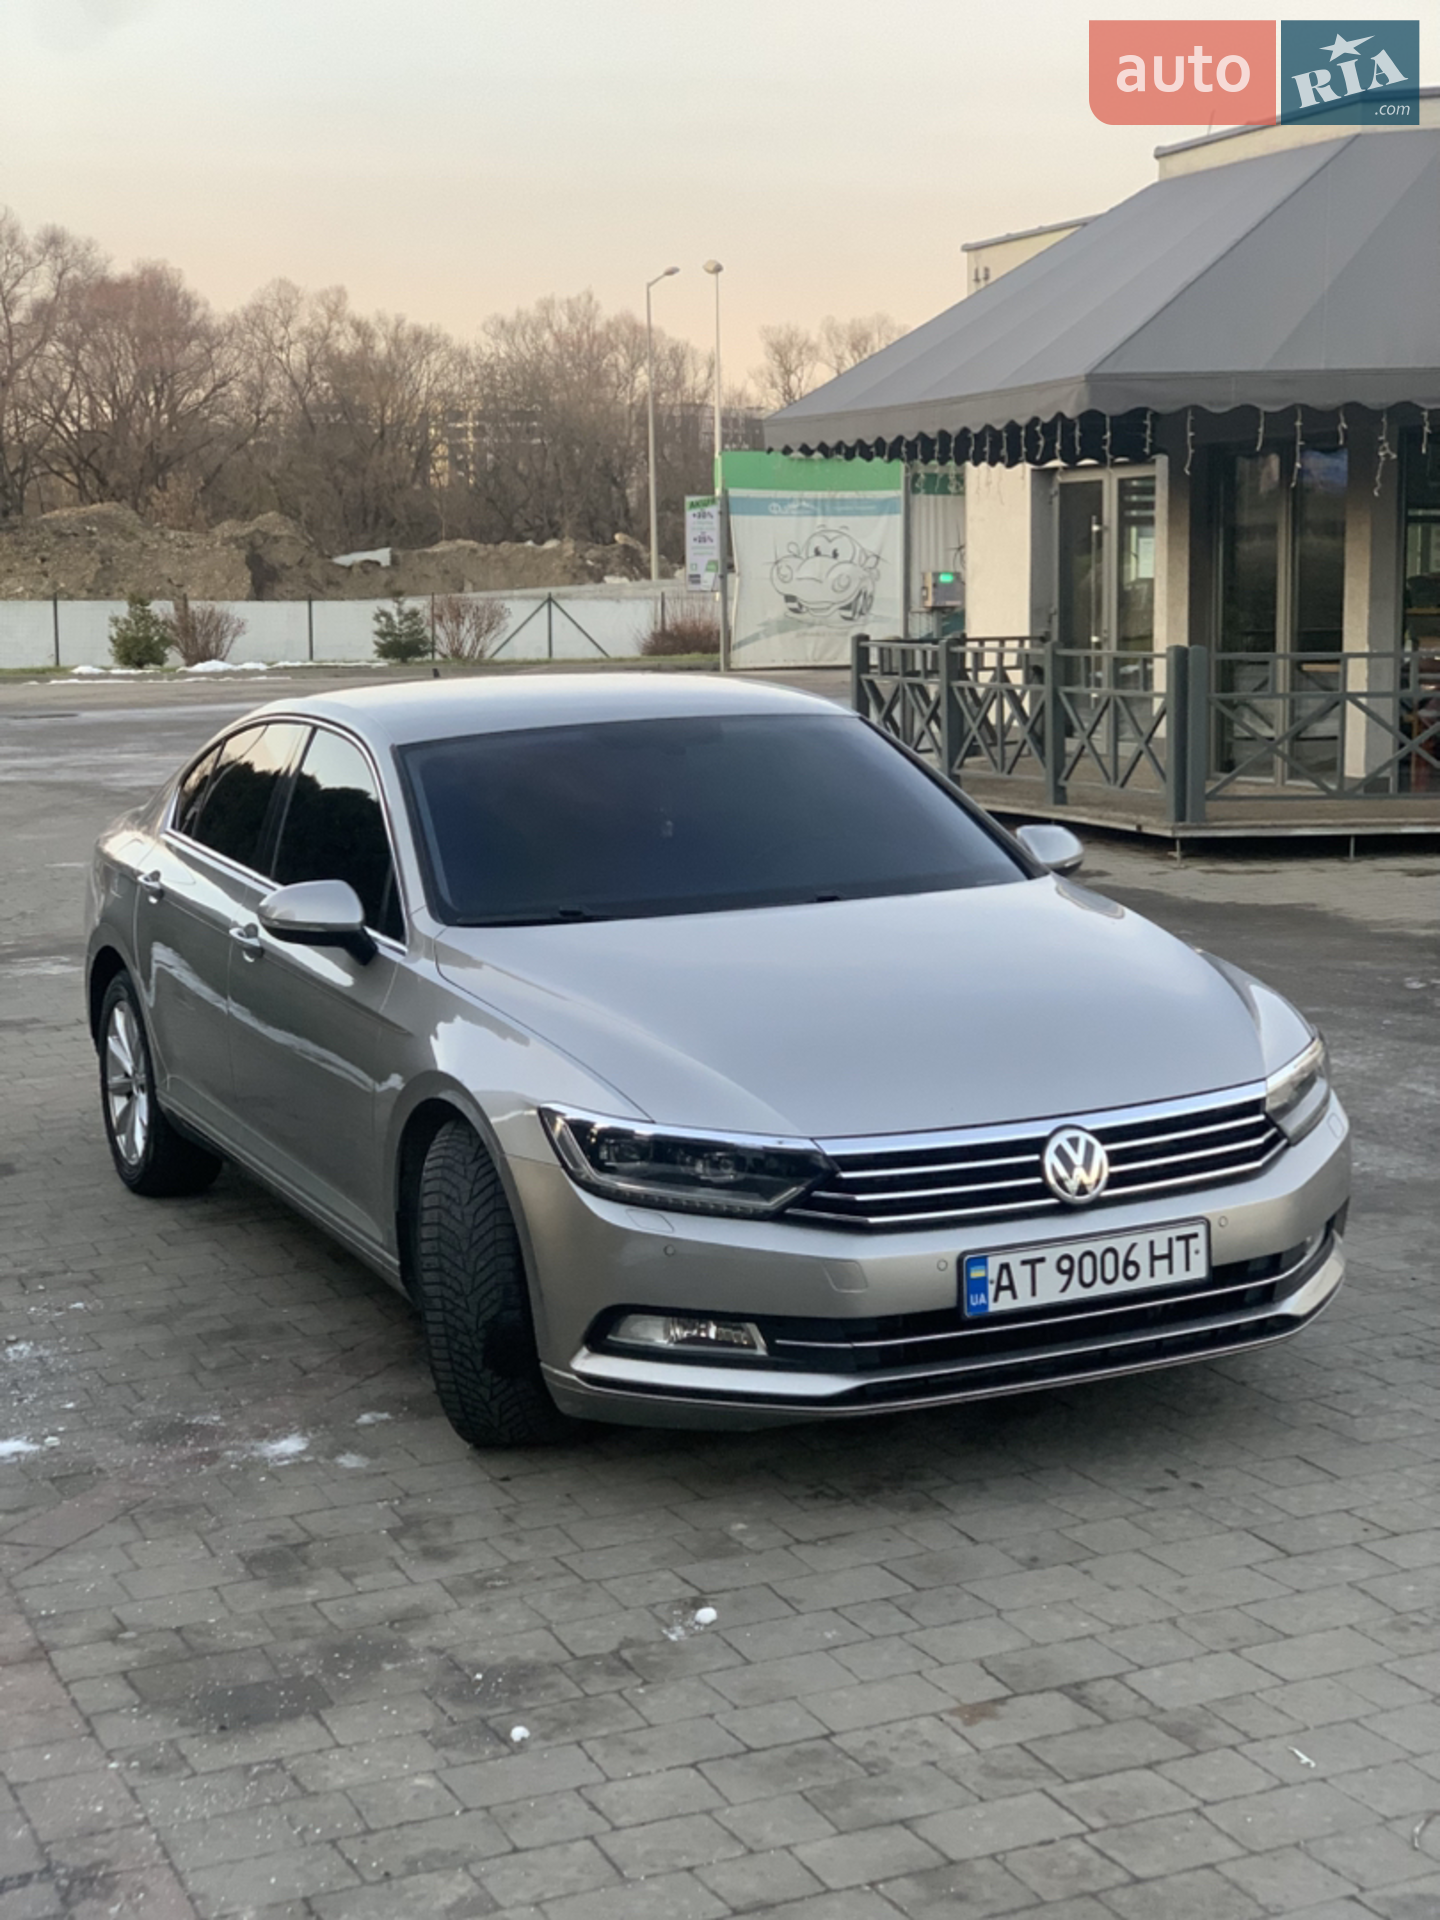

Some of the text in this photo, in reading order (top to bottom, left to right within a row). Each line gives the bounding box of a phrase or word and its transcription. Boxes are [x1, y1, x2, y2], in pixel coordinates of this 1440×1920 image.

[993, 1232, 1199, 1303] AT 9006 HT
[970, 1293, 988, 1306] UA
